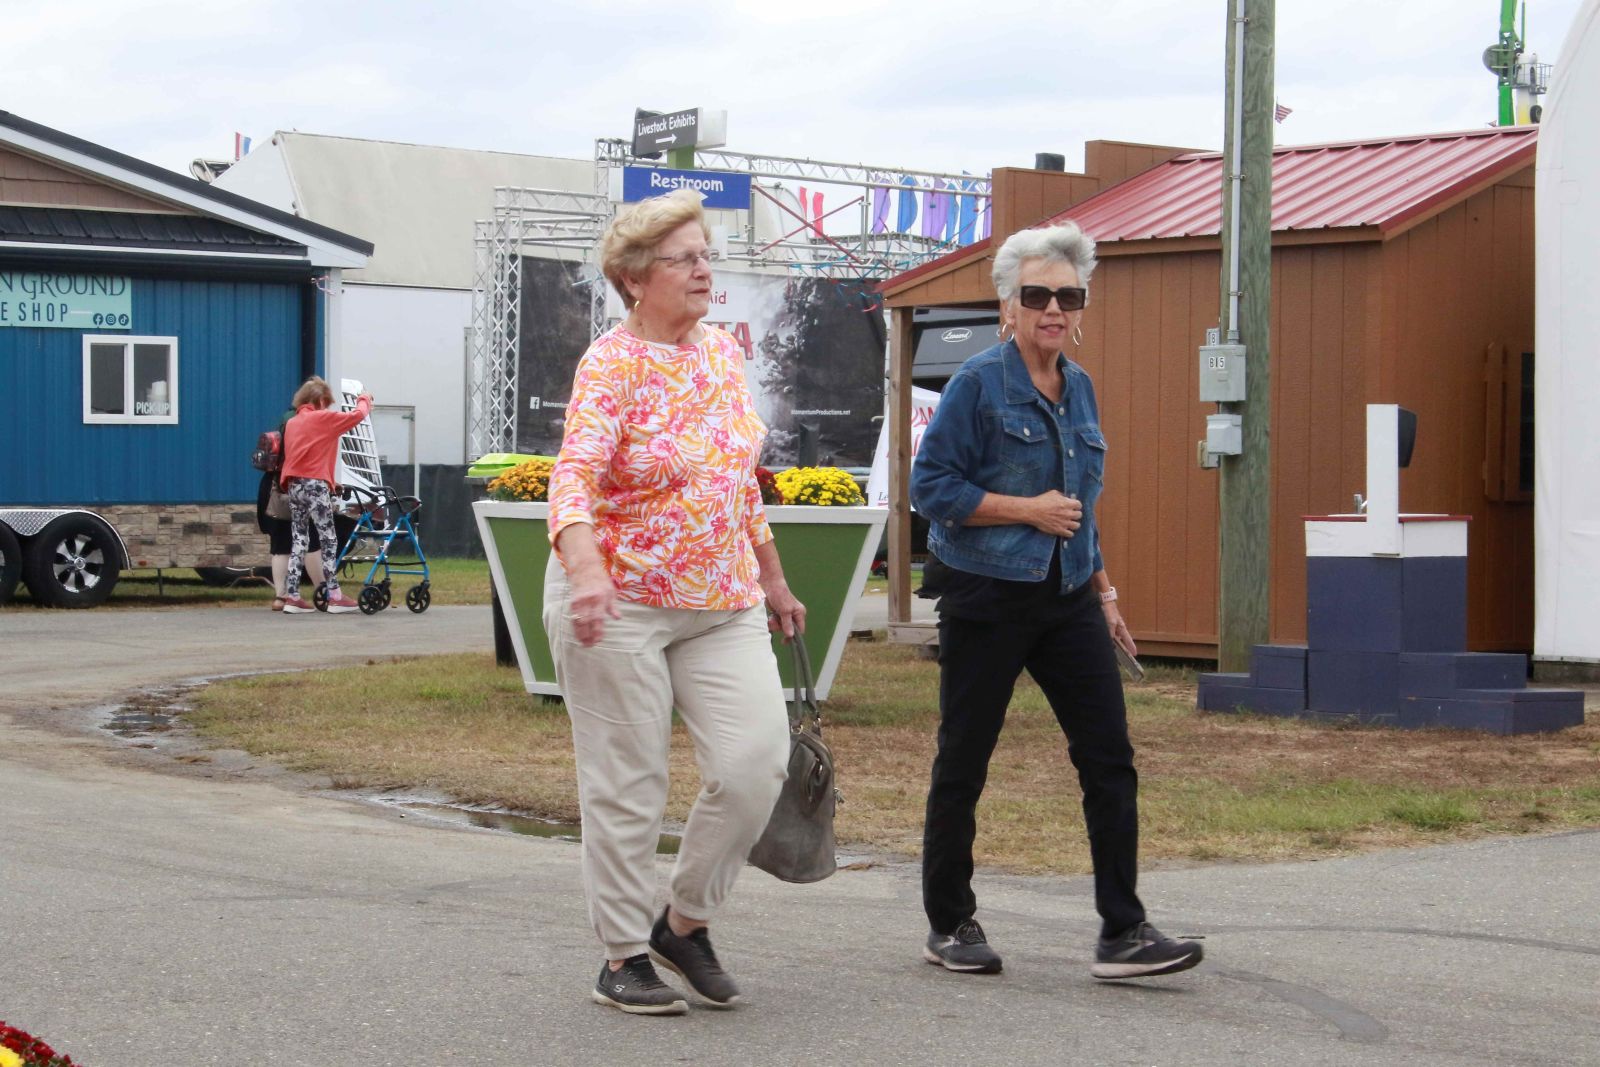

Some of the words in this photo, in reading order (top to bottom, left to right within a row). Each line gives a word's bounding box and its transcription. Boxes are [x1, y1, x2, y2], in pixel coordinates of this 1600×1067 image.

[637, 118, 667, 137] Livestock
[668, 115, 696, 130] Exhibits
[650, 172, 724, 191] Restroom
[20, 272, 126, 300] GROUND
[18, 302, 68, 322] SHOP
